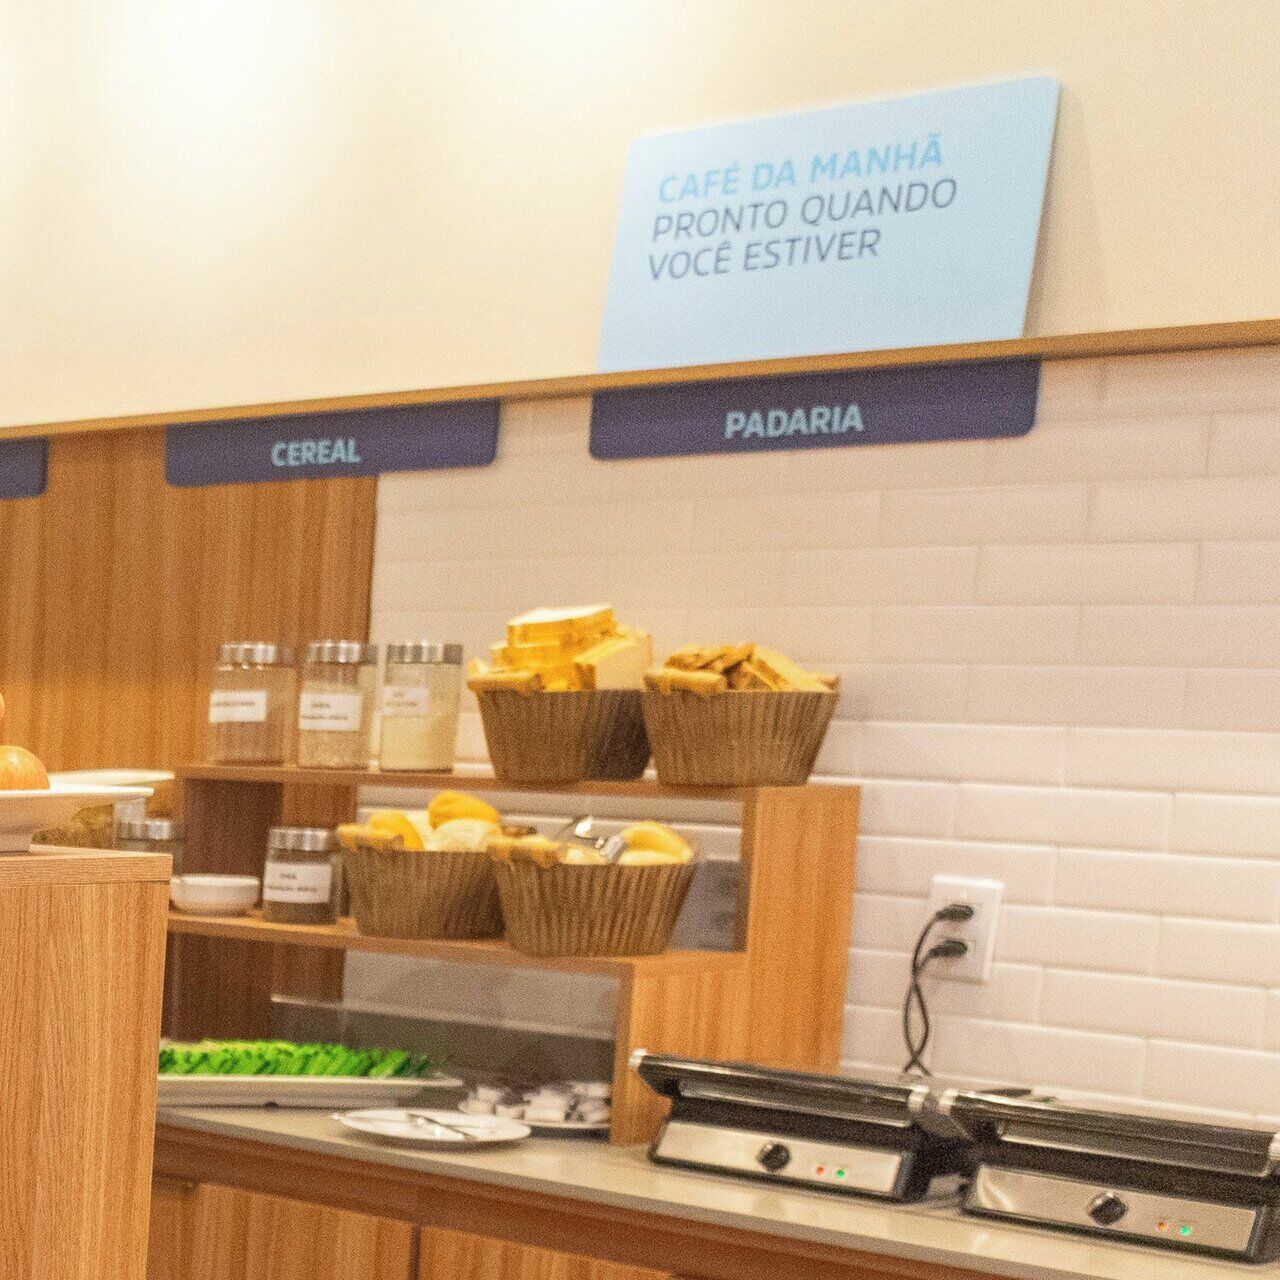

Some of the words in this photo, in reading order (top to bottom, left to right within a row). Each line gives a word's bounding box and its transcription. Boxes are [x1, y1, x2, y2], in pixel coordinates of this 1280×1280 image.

[660, 161, 741, 203] CAFÉ
[751, 159, 797, 193] DA
[811, 134, 943, 183] MANHÃ
[654, 200, 788, 242] PRONTO
[802, 179, 957, 226] QUANDO
[649, 242, 730, 280] VOCÊ
[744, 229, 881, 271] ESTIVER
[725, 404, 864, 438] PADARIA
[272, 440, 362, 466] CEREAL
